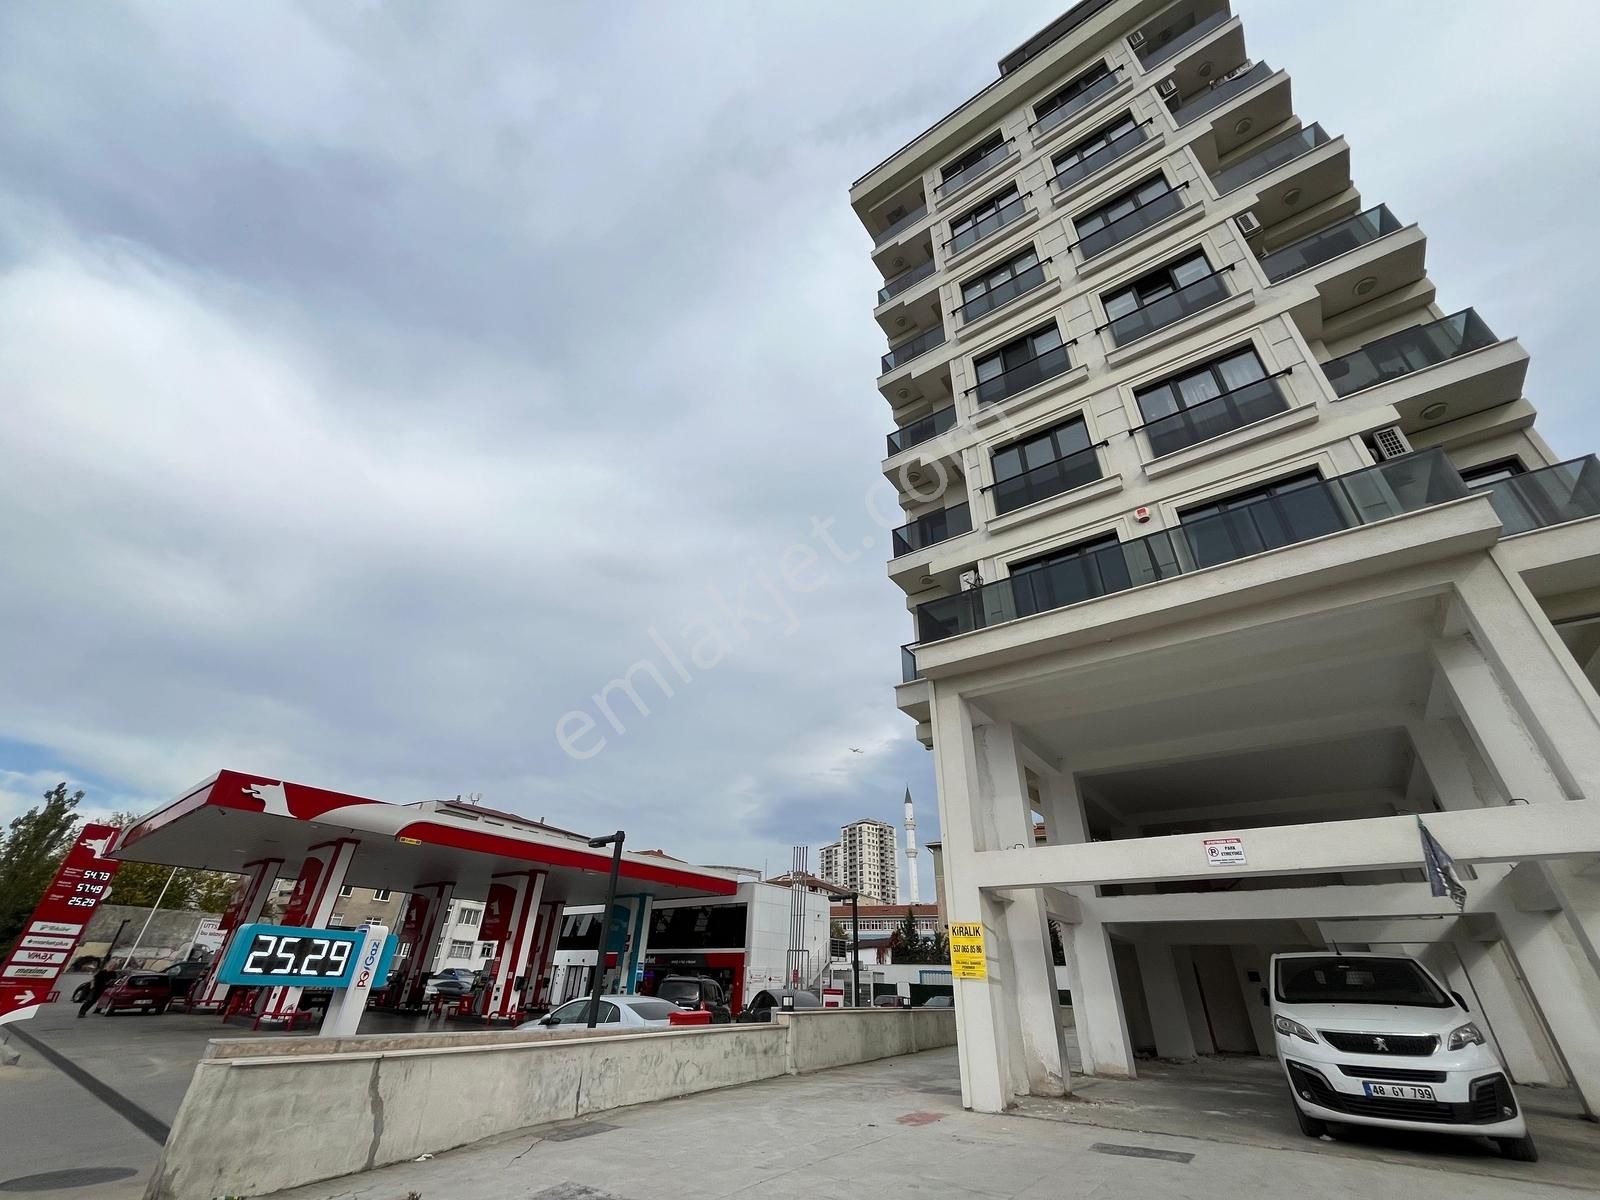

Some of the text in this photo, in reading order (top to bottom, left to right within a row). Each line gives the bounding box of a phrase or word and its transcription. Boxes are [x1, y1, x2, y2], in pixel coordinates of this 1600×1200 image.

[83, 870, 110, 881] 54.73
[76, 883, 103, 894] 57.49
[68, 896, 96, 907] 25.29
[243, 935, 352, 976] 25.29
[1373, 1085, 1432, 1099] 48 GY 799
